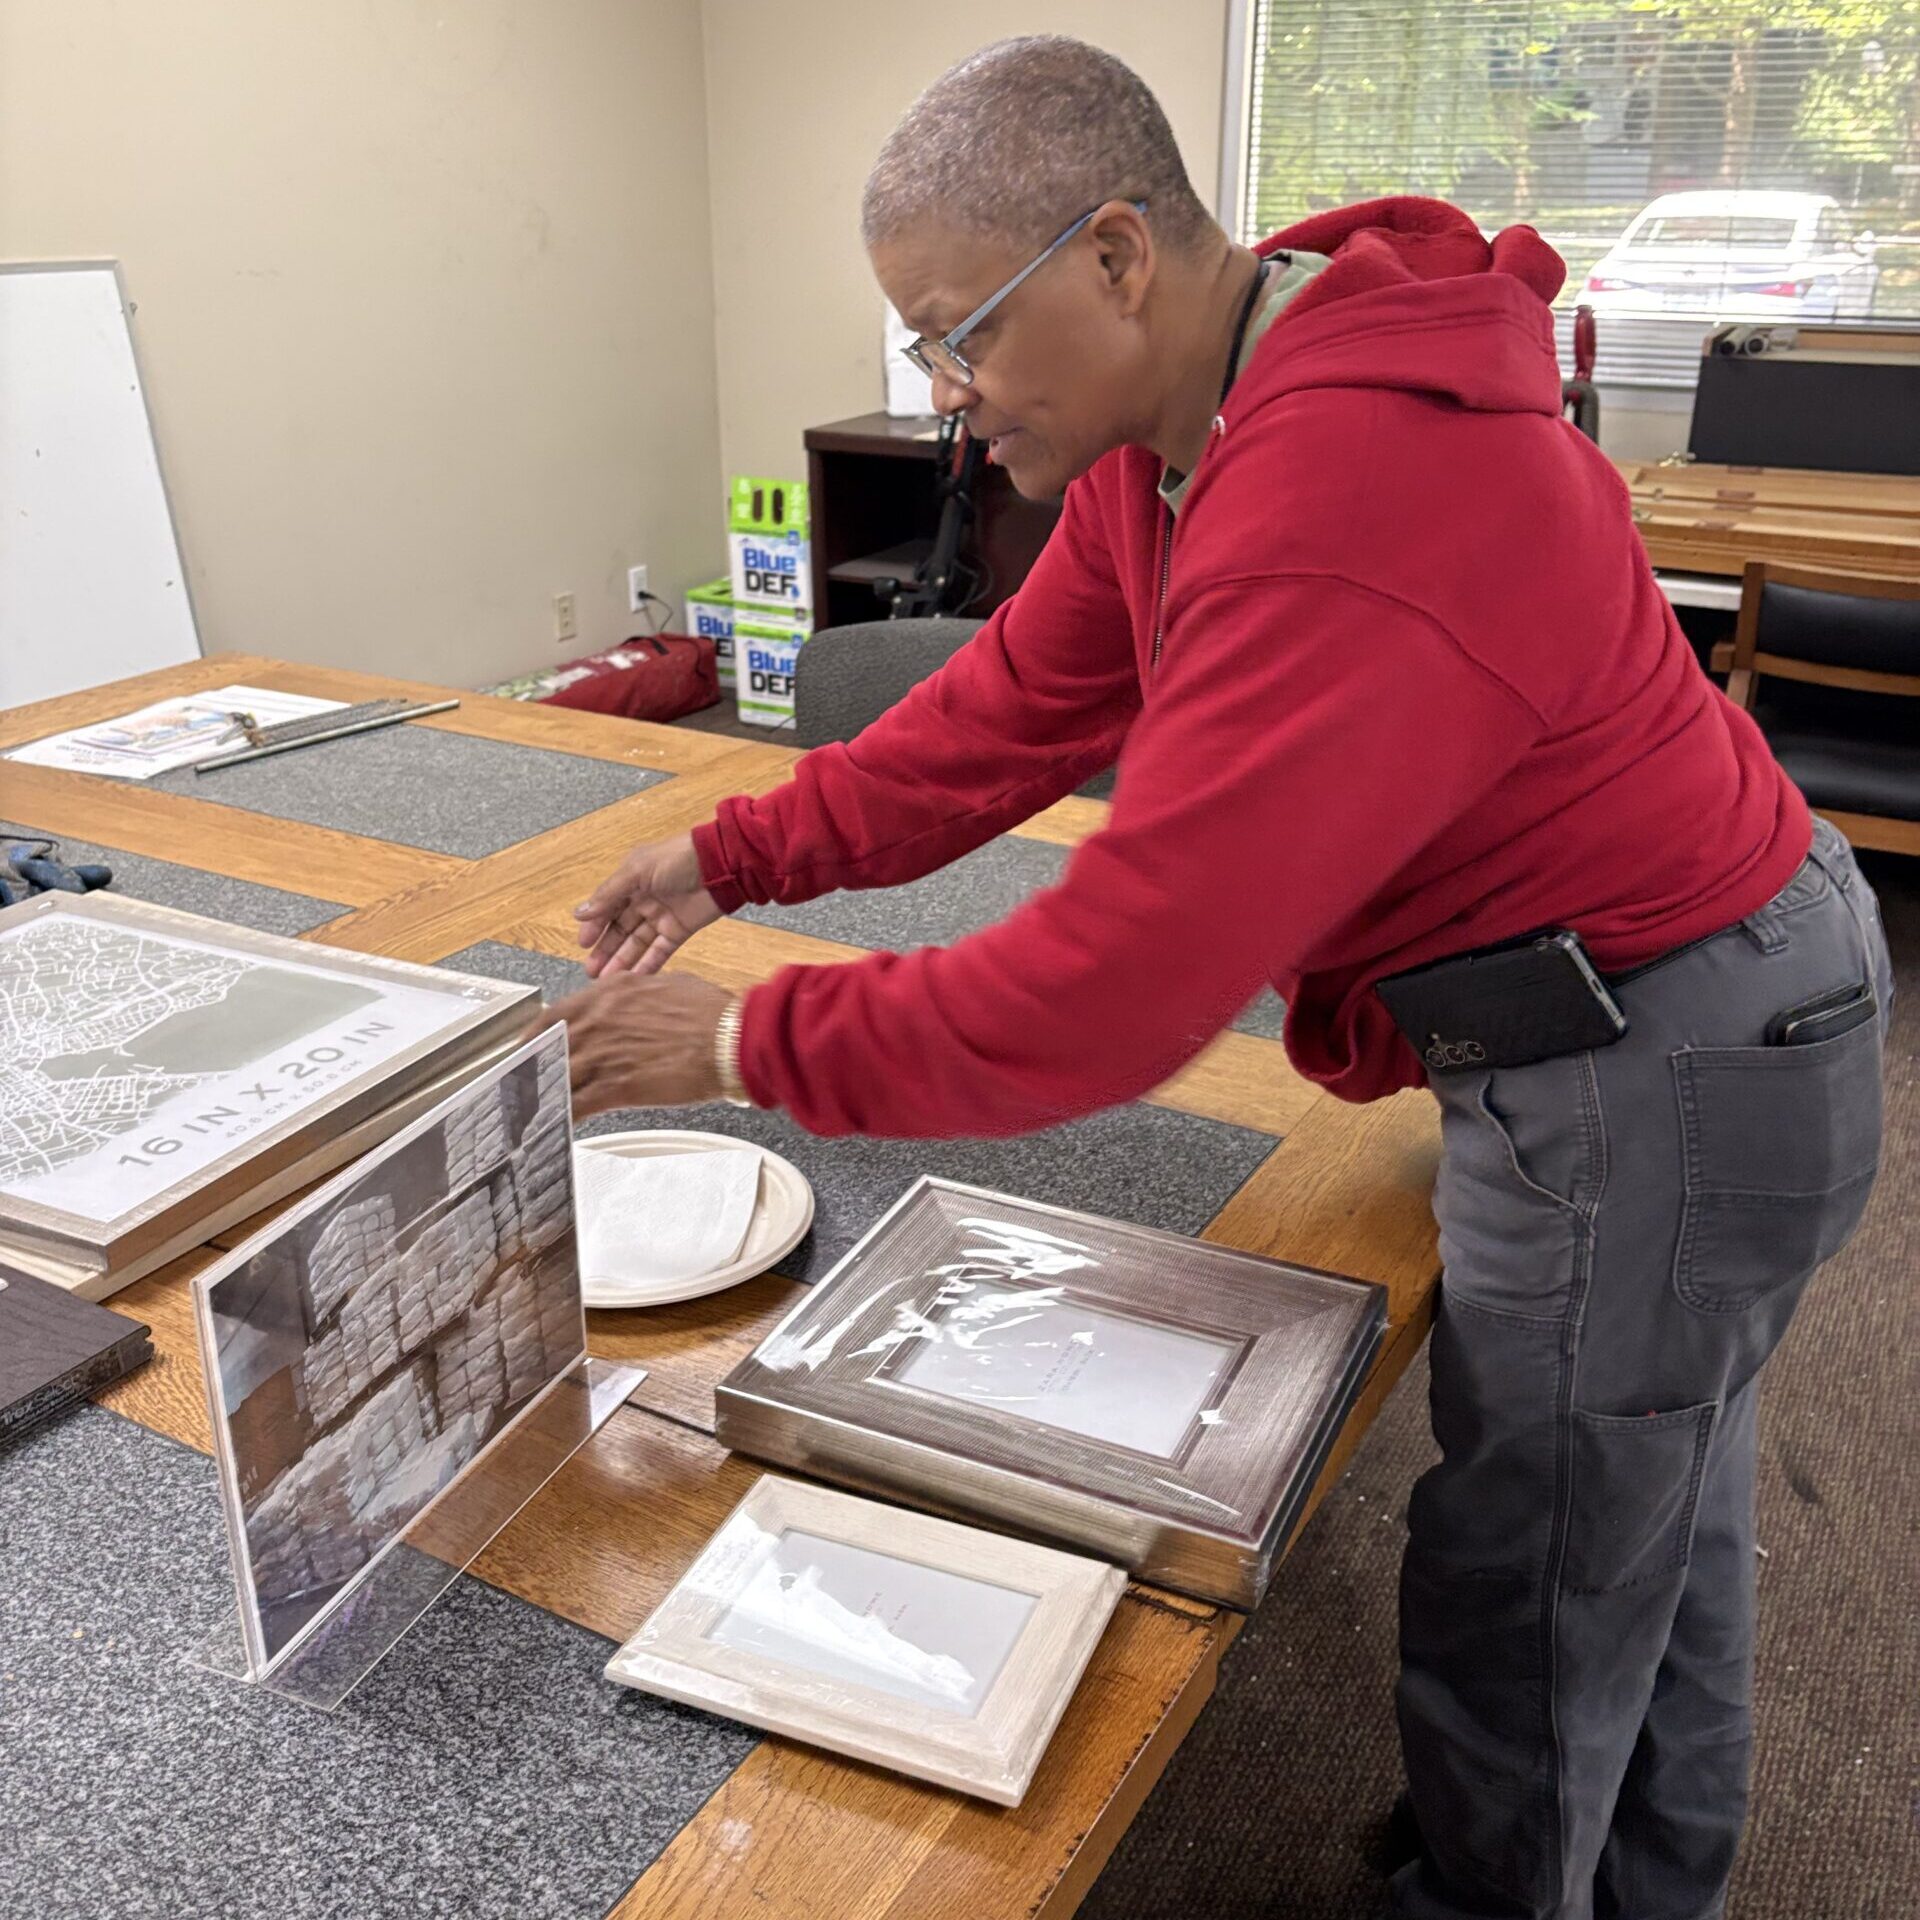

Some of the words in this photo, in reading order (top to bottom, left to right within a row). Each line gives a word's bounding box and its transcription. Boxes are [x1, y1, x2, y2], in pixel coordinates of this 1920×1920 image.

[743, 548, 797, 573] Blue
[745, 570, 798, 596] DEF
[697, 615, 734, 637] Blu
[117, 1136, 184, 1167] 16
[182, 1105, 241, 1135] IN
[238, 1082, 284, 1102] X
[278, 1047, 345, 1080] 20
[342, 1021, 396, 1046] IN
